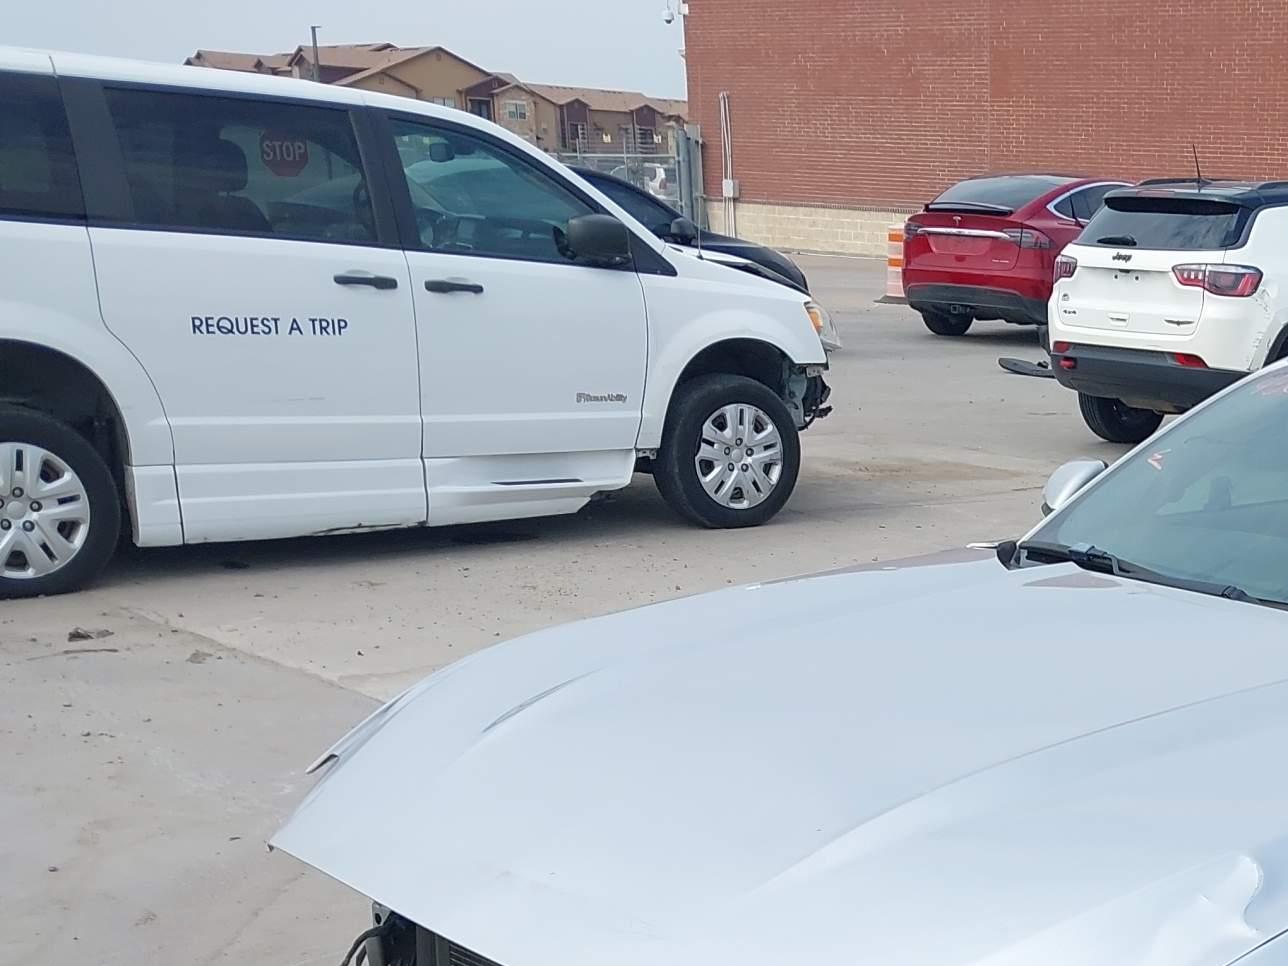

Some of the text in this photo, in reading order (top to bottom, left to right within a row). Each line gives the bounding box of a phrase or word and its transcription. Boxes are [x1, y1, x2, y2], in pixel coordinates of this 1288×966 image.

[264, 141, 305, 160] STOP
[191, 316, 348, 336] REQUEST A TRIP
